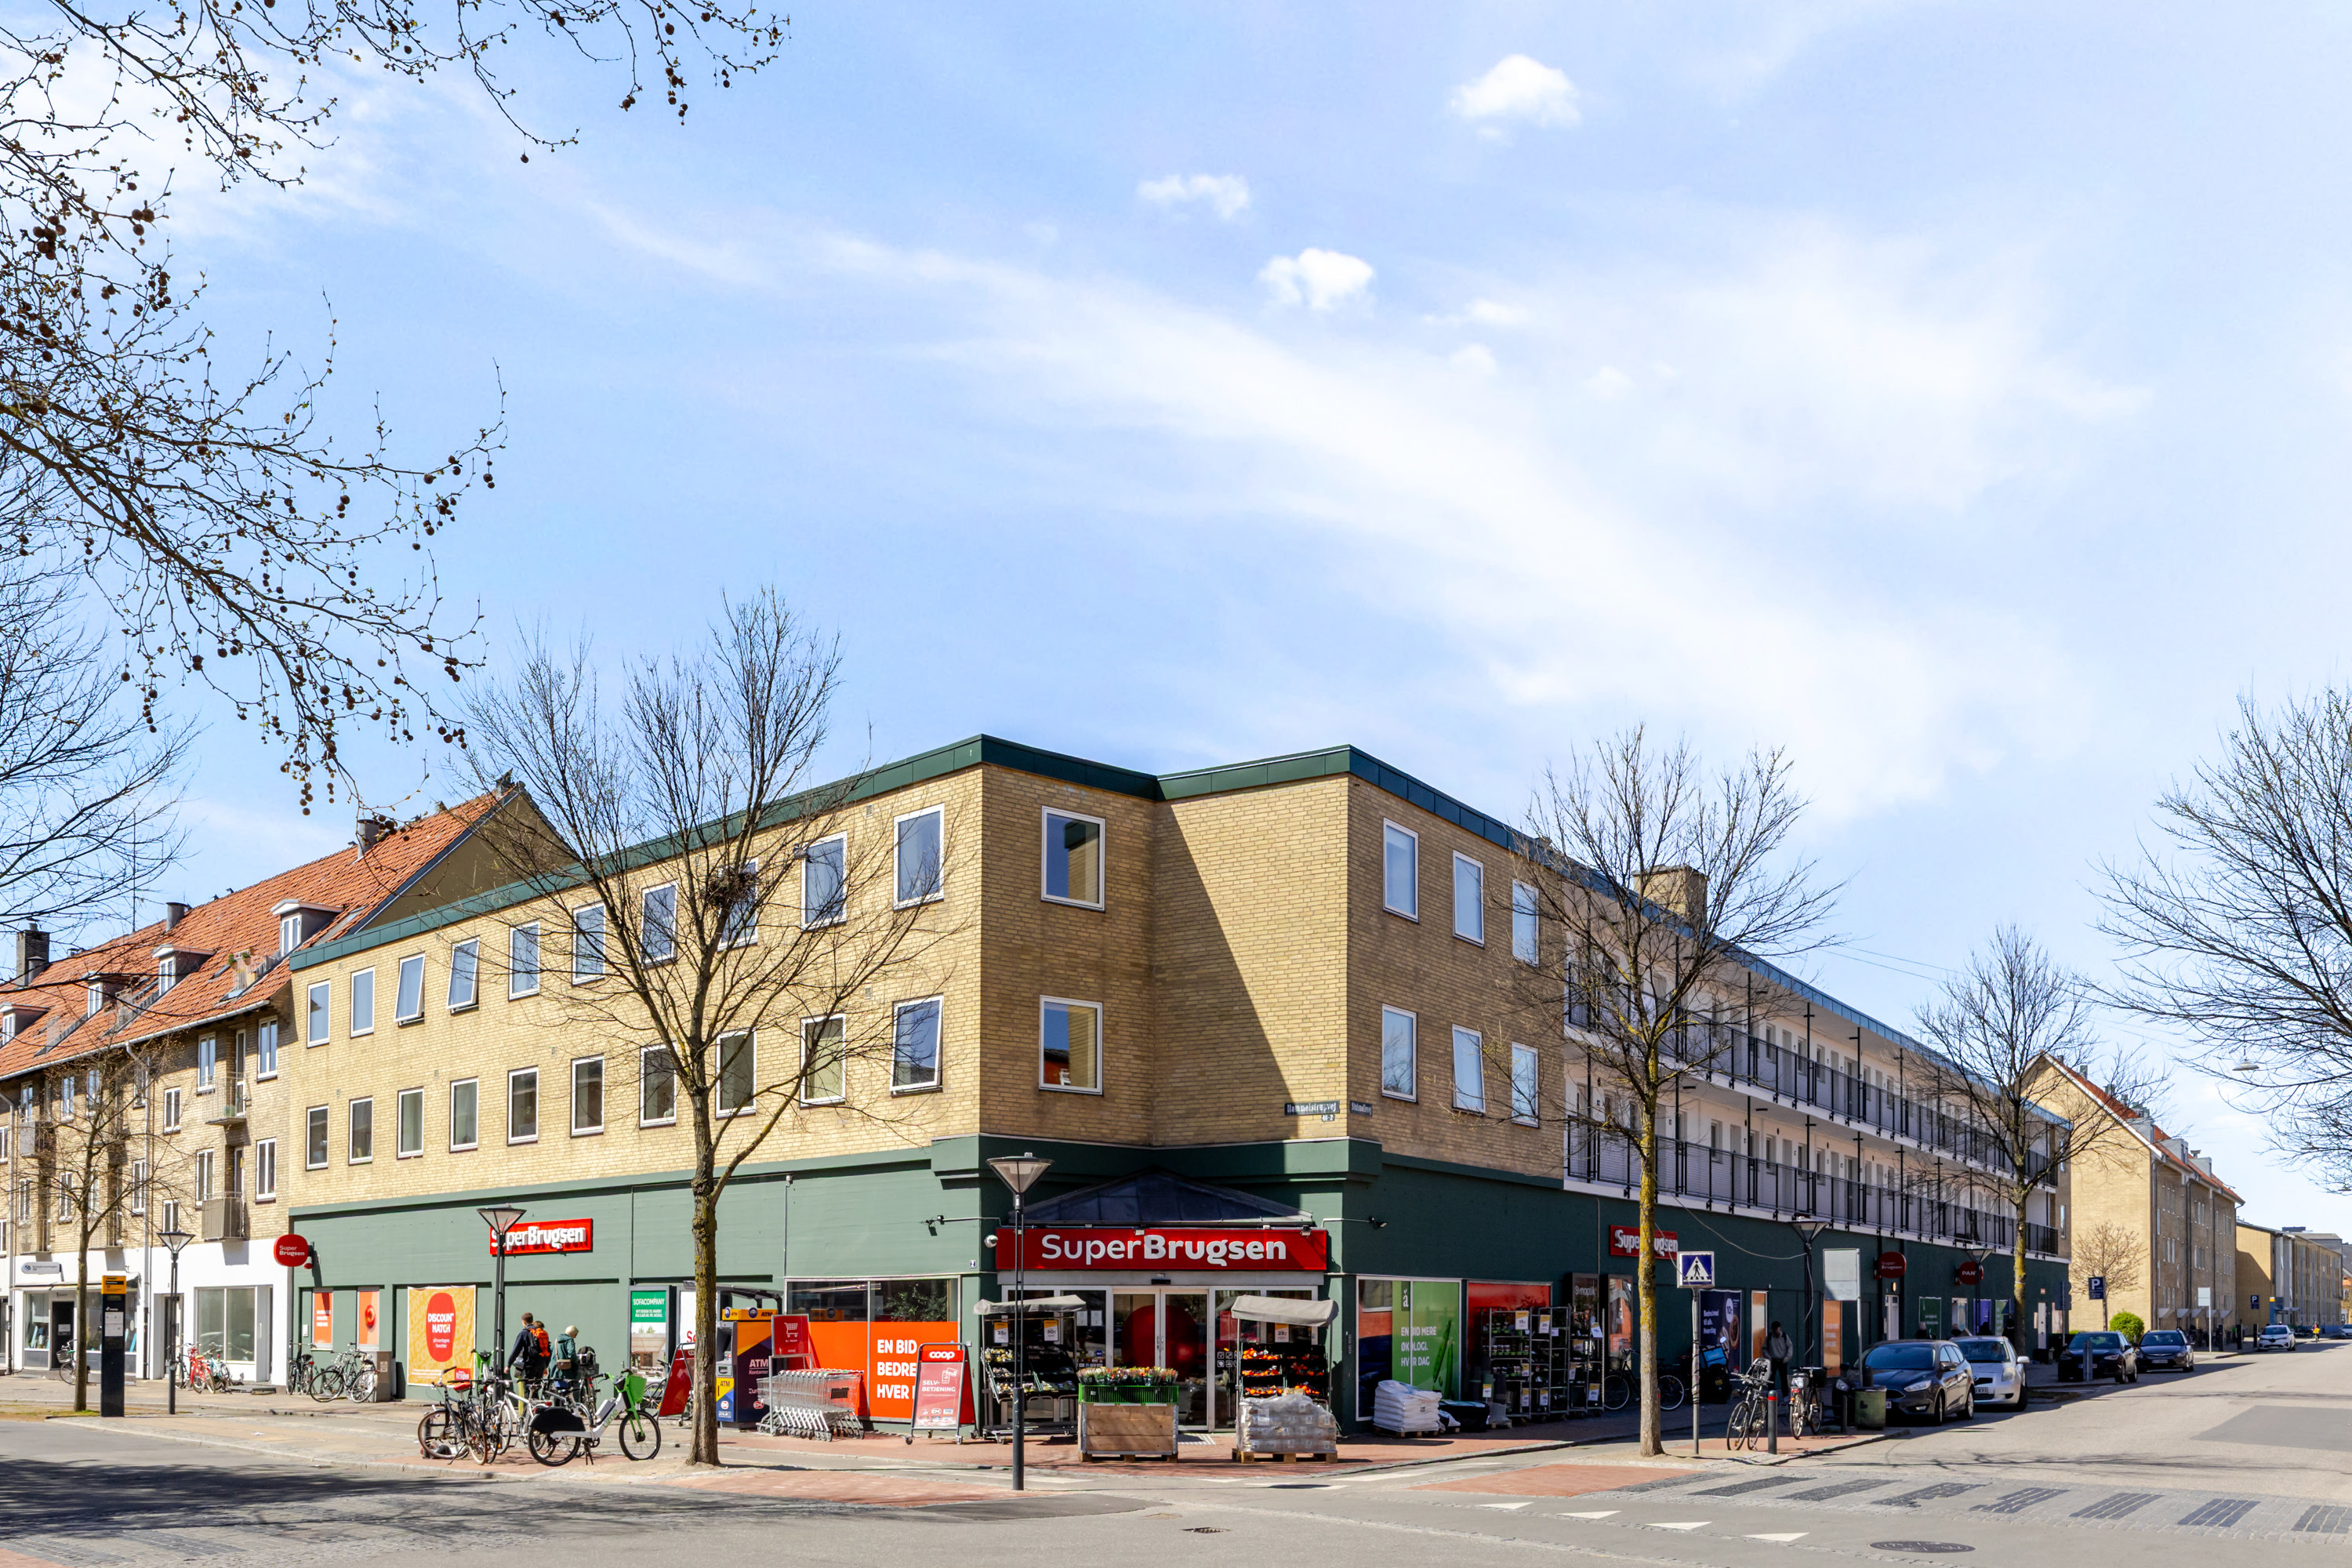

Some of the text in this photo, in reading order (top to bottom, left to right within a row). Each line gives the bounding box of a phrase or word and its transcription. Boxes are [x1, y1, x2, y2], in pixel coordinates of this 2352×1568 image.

[1041, 1233, 1287, 1267] SuperBrugsen
[2091, 1279, 2100, 1290] P
[432, 1323, 451, 1334] MATCH
[1400, 1327, 1410, 1337] EN
[1421, 1326, 1437, 1336] MERE
[877, 1339, 917, 1354] EN BID
[929, 1351, 956, 1360] coop
[749, 1359, 769, 1368] ATM
[1400, 1356, 1417, 1367] HVR
[877, 1361, 917, 1377] BEDRE
[877, 1384, 909, 1399] HVER
